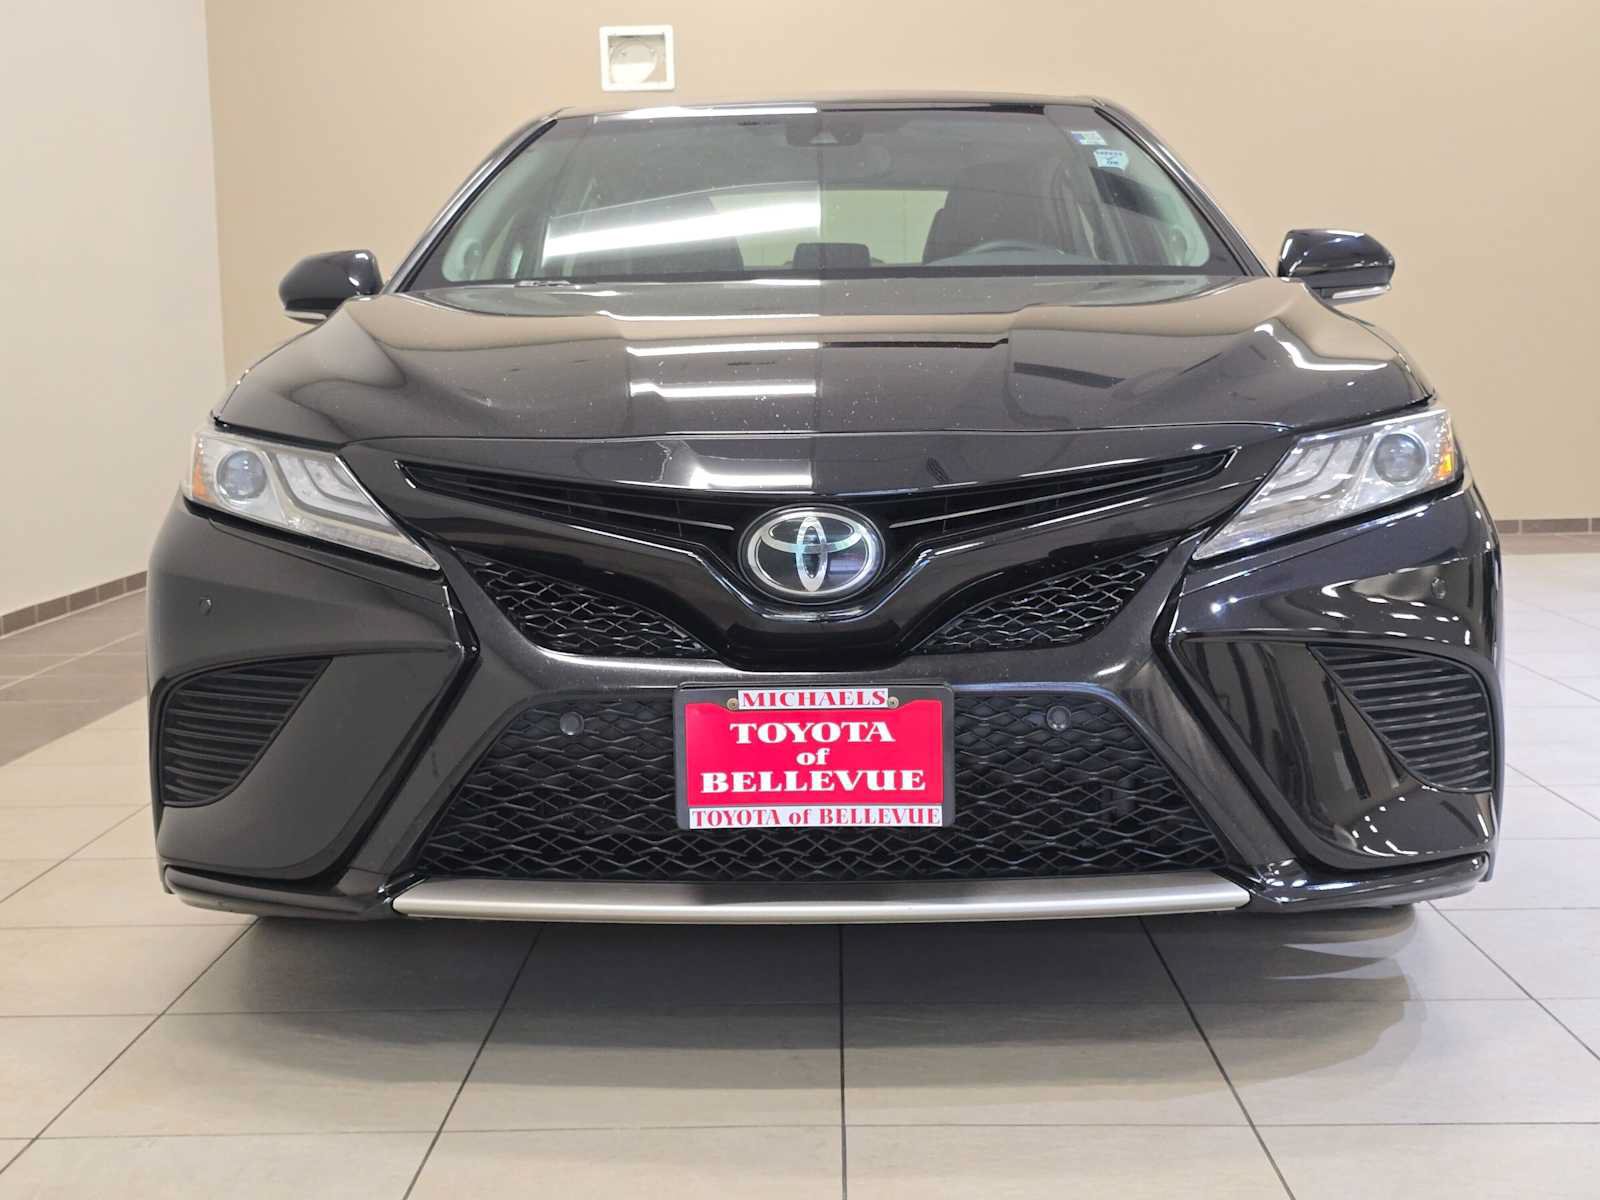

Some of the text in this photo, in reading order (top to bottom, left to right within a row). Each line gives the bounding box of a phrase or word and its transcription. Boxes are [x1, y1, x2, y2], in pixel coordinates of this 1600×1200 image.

[742, 690, 887, 707] MICHAELS
[729, 721, 896, 744] TOYOTA
[796, 747, 830, 766] of
[700, 769, 926, 794] BELLEVUE
[691, 806, 941, 827] TOYOTA of BELLEVUE
